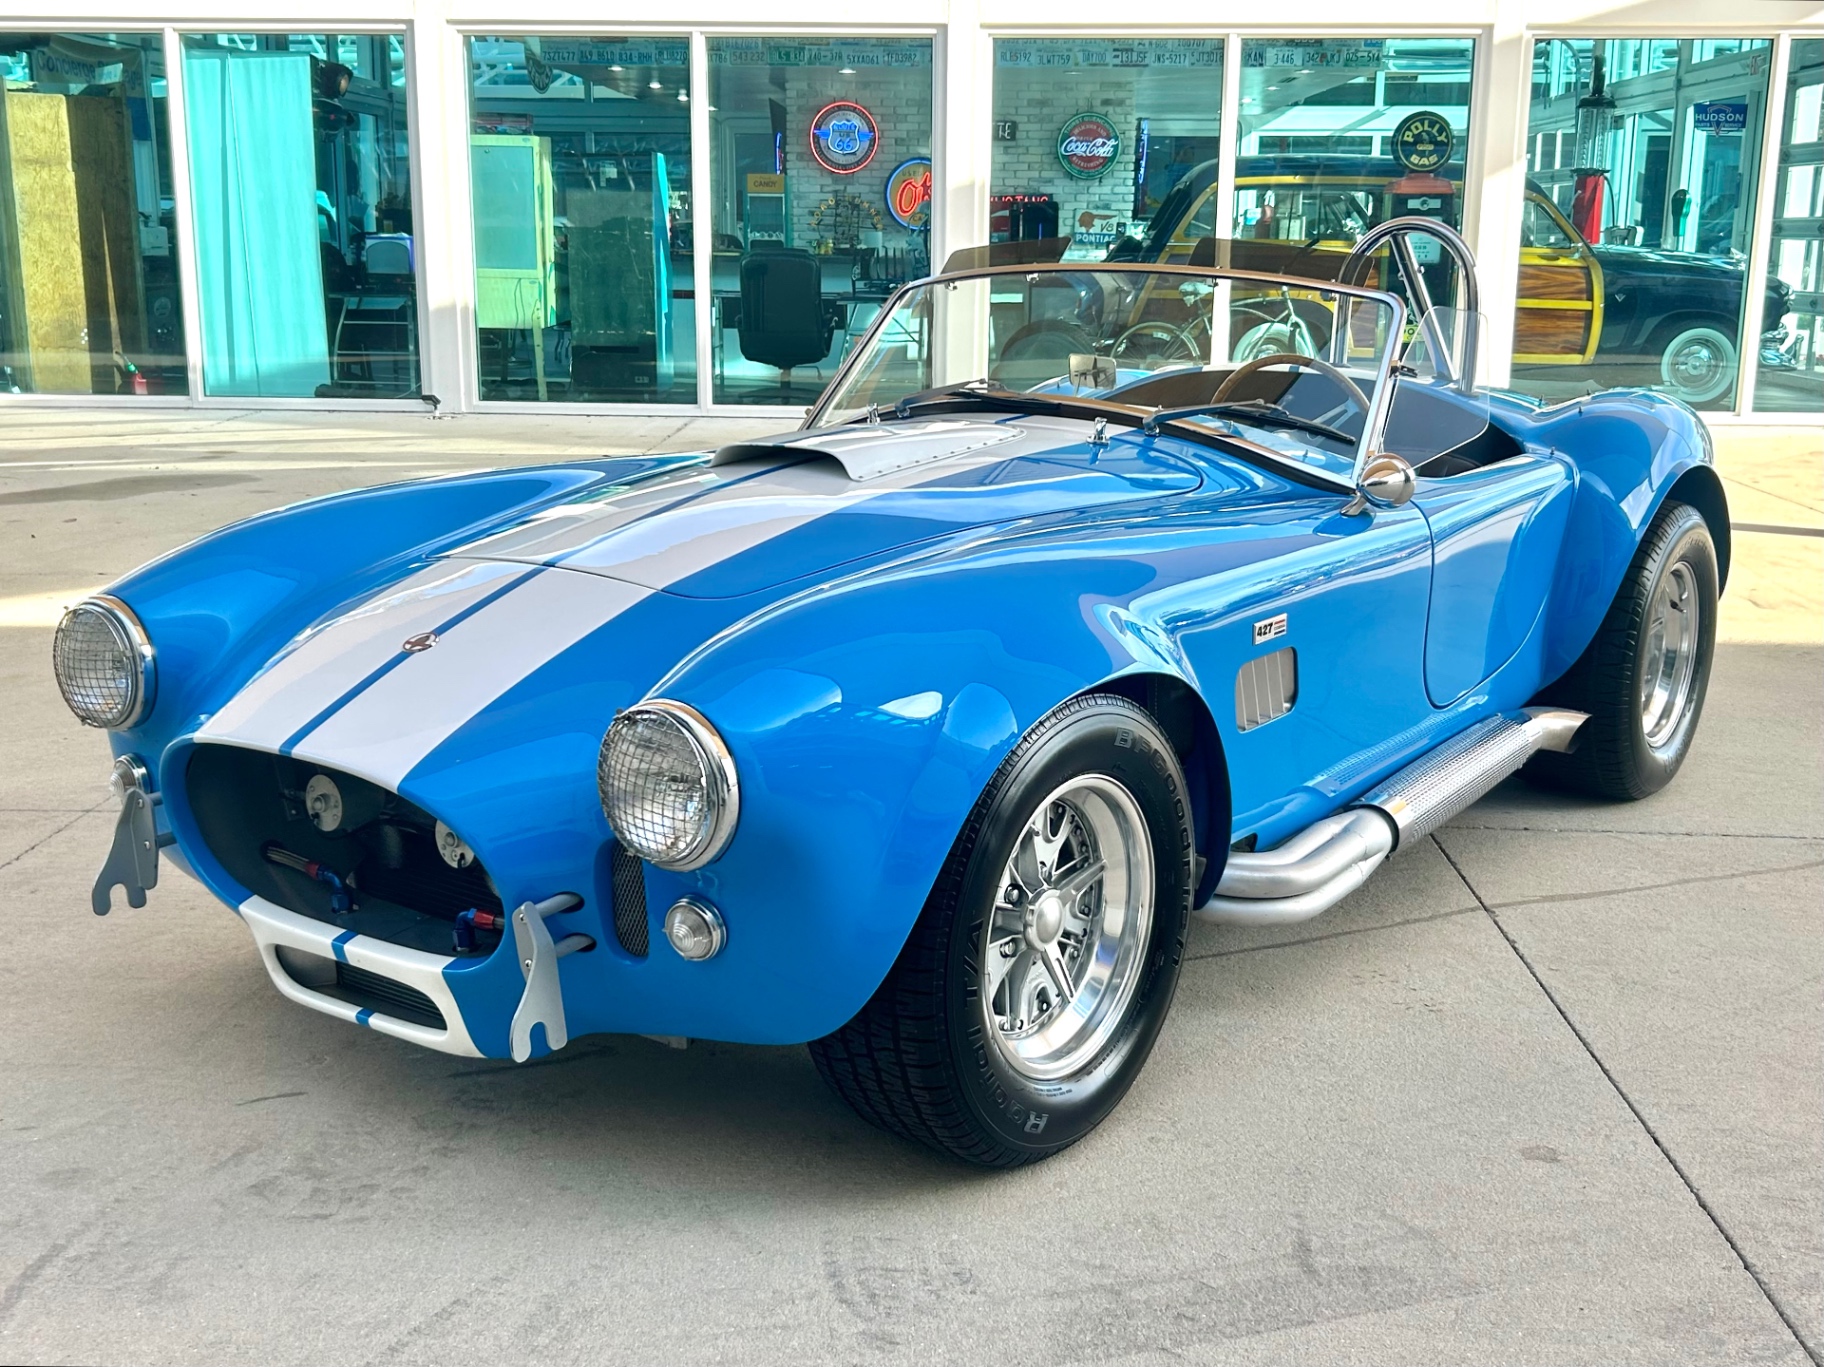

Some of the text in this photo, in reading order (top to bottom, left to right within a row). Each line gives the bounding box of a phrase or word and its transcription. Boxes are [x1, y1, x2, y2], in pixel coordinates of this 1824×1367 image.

[1695, 113, 1744, 121] HUDSON
[1403, 120, 1447, 143] POLLY
[834, 137, 853, 150] 66
[1060, 136, 1119, 157] Coca-Cola
[1410, 154, 1439, 166] GAS
[753, 180, 778, 188] CANDY
[1100, 220, 1114, 233] V8
[1257, 622, 1273, 637] 427
